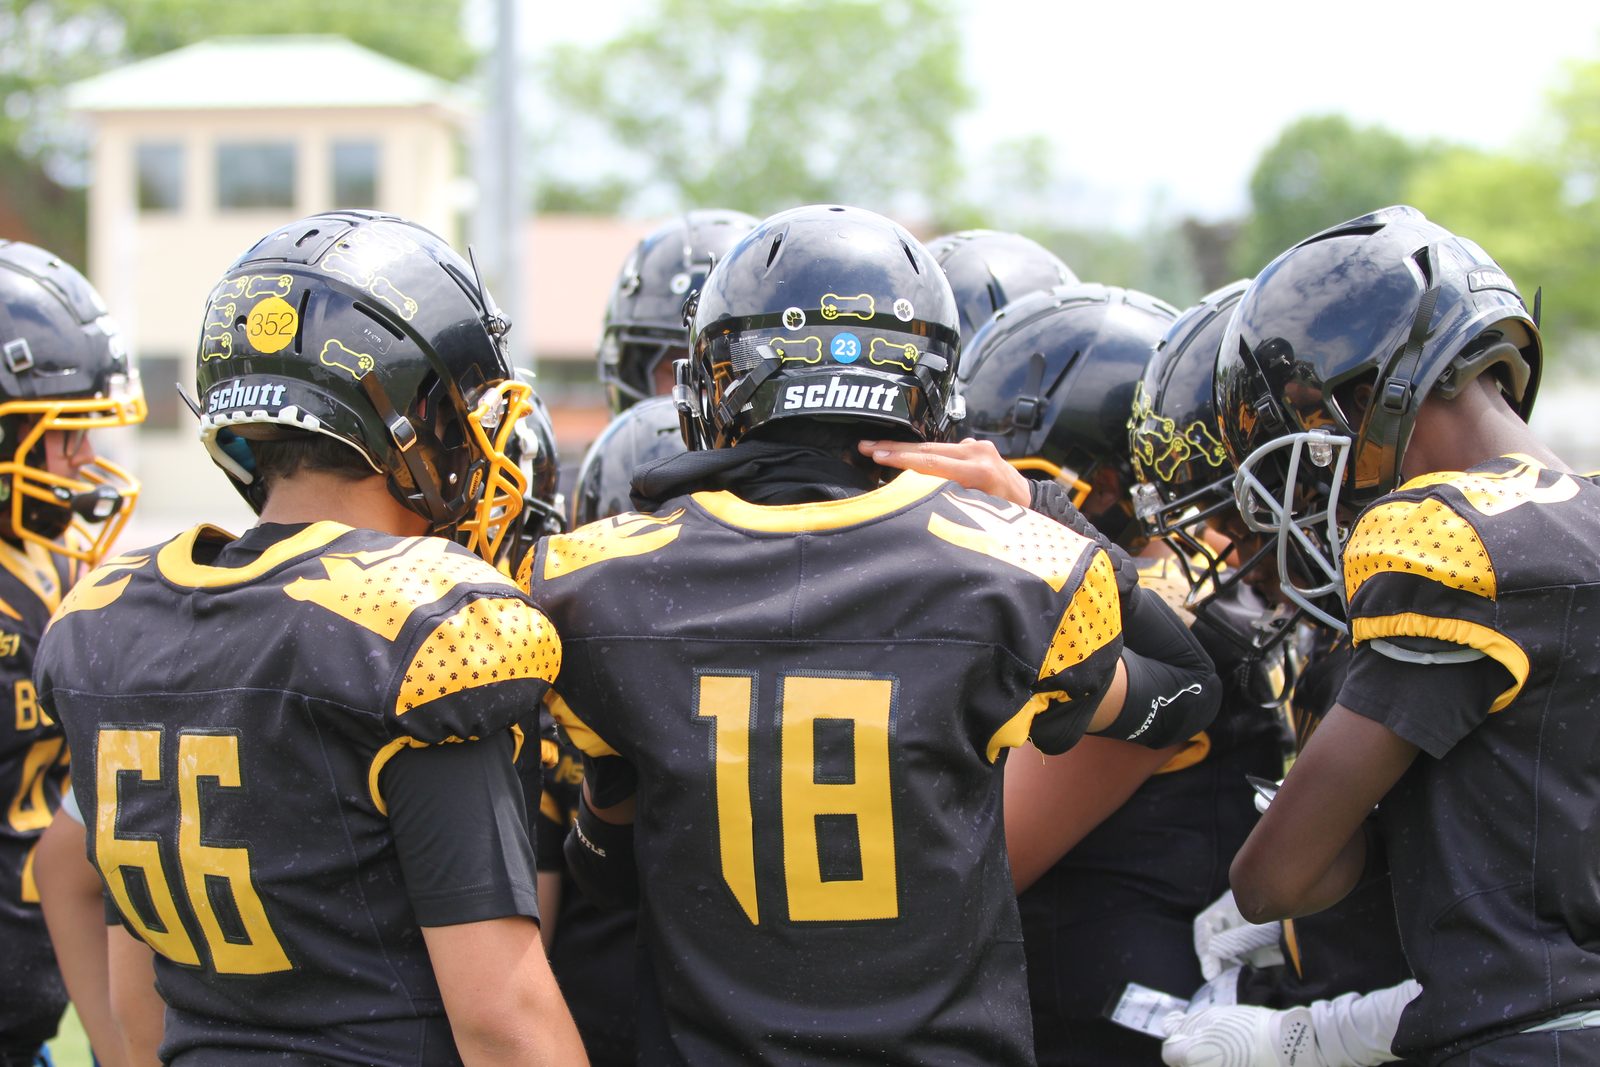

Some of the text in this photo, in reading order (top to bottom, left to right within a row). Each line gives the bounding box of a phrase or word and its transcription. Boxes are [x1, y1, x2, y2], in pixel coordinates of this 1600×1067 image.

[251, 312, 294, 336] 352
[834, 339, 857, 357] 23
[209, 379, 286, 413] schutt
[783, 376, 899, 412] schutt
[695, 671, 900, 926] 18
[96, 726, 293, 976] 66
